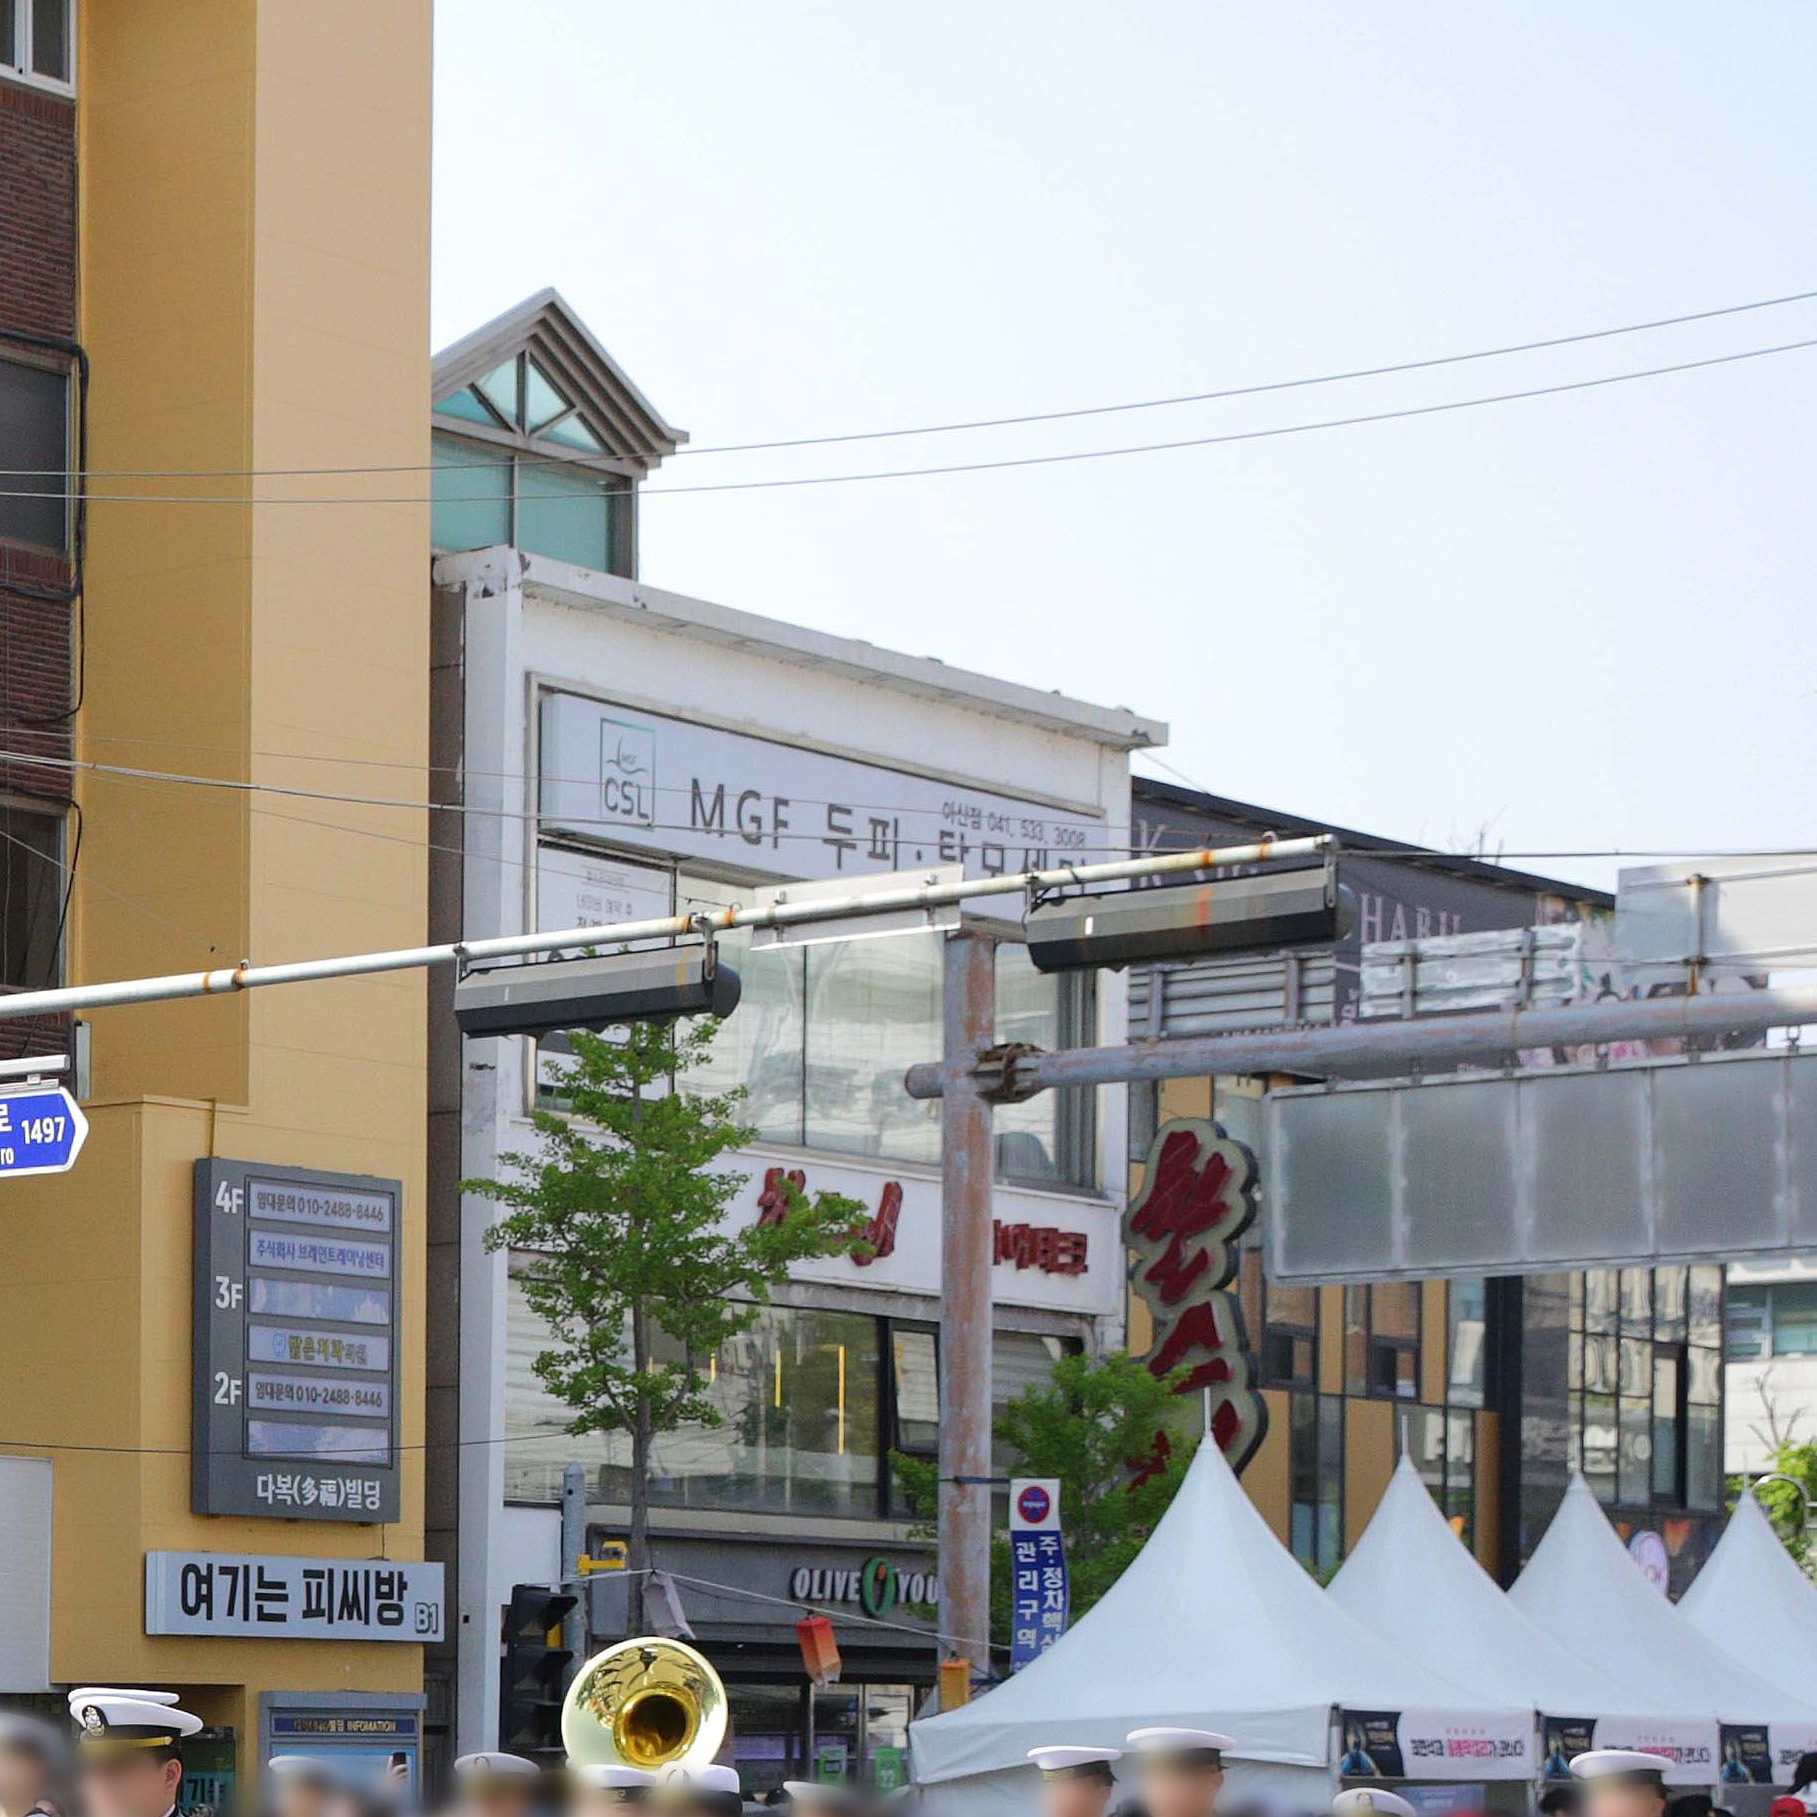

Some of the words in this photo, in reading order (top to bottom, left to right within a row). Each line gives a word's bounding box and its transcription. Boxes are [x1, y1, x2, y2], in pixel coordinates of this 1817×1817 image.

[604, 777, 650, 820] CSL
[691, 777, 790, 850] MGF
[21, 1116, 65, 1145] 1497
[215, 1180, 244, 1214] 4F
[215, 1275, 244, 1309] 3F
[214, 1371, 243, 1405] 2F
[180, 1562, 289, 1623] 여기는
[301, 1567, 409, 1627] 피씨방
[415, 1601, 439, 1634] B1
[793, 1566, 860, 1602] OLIVE
[1016, 1541, 1038, 1649] 관리구역
